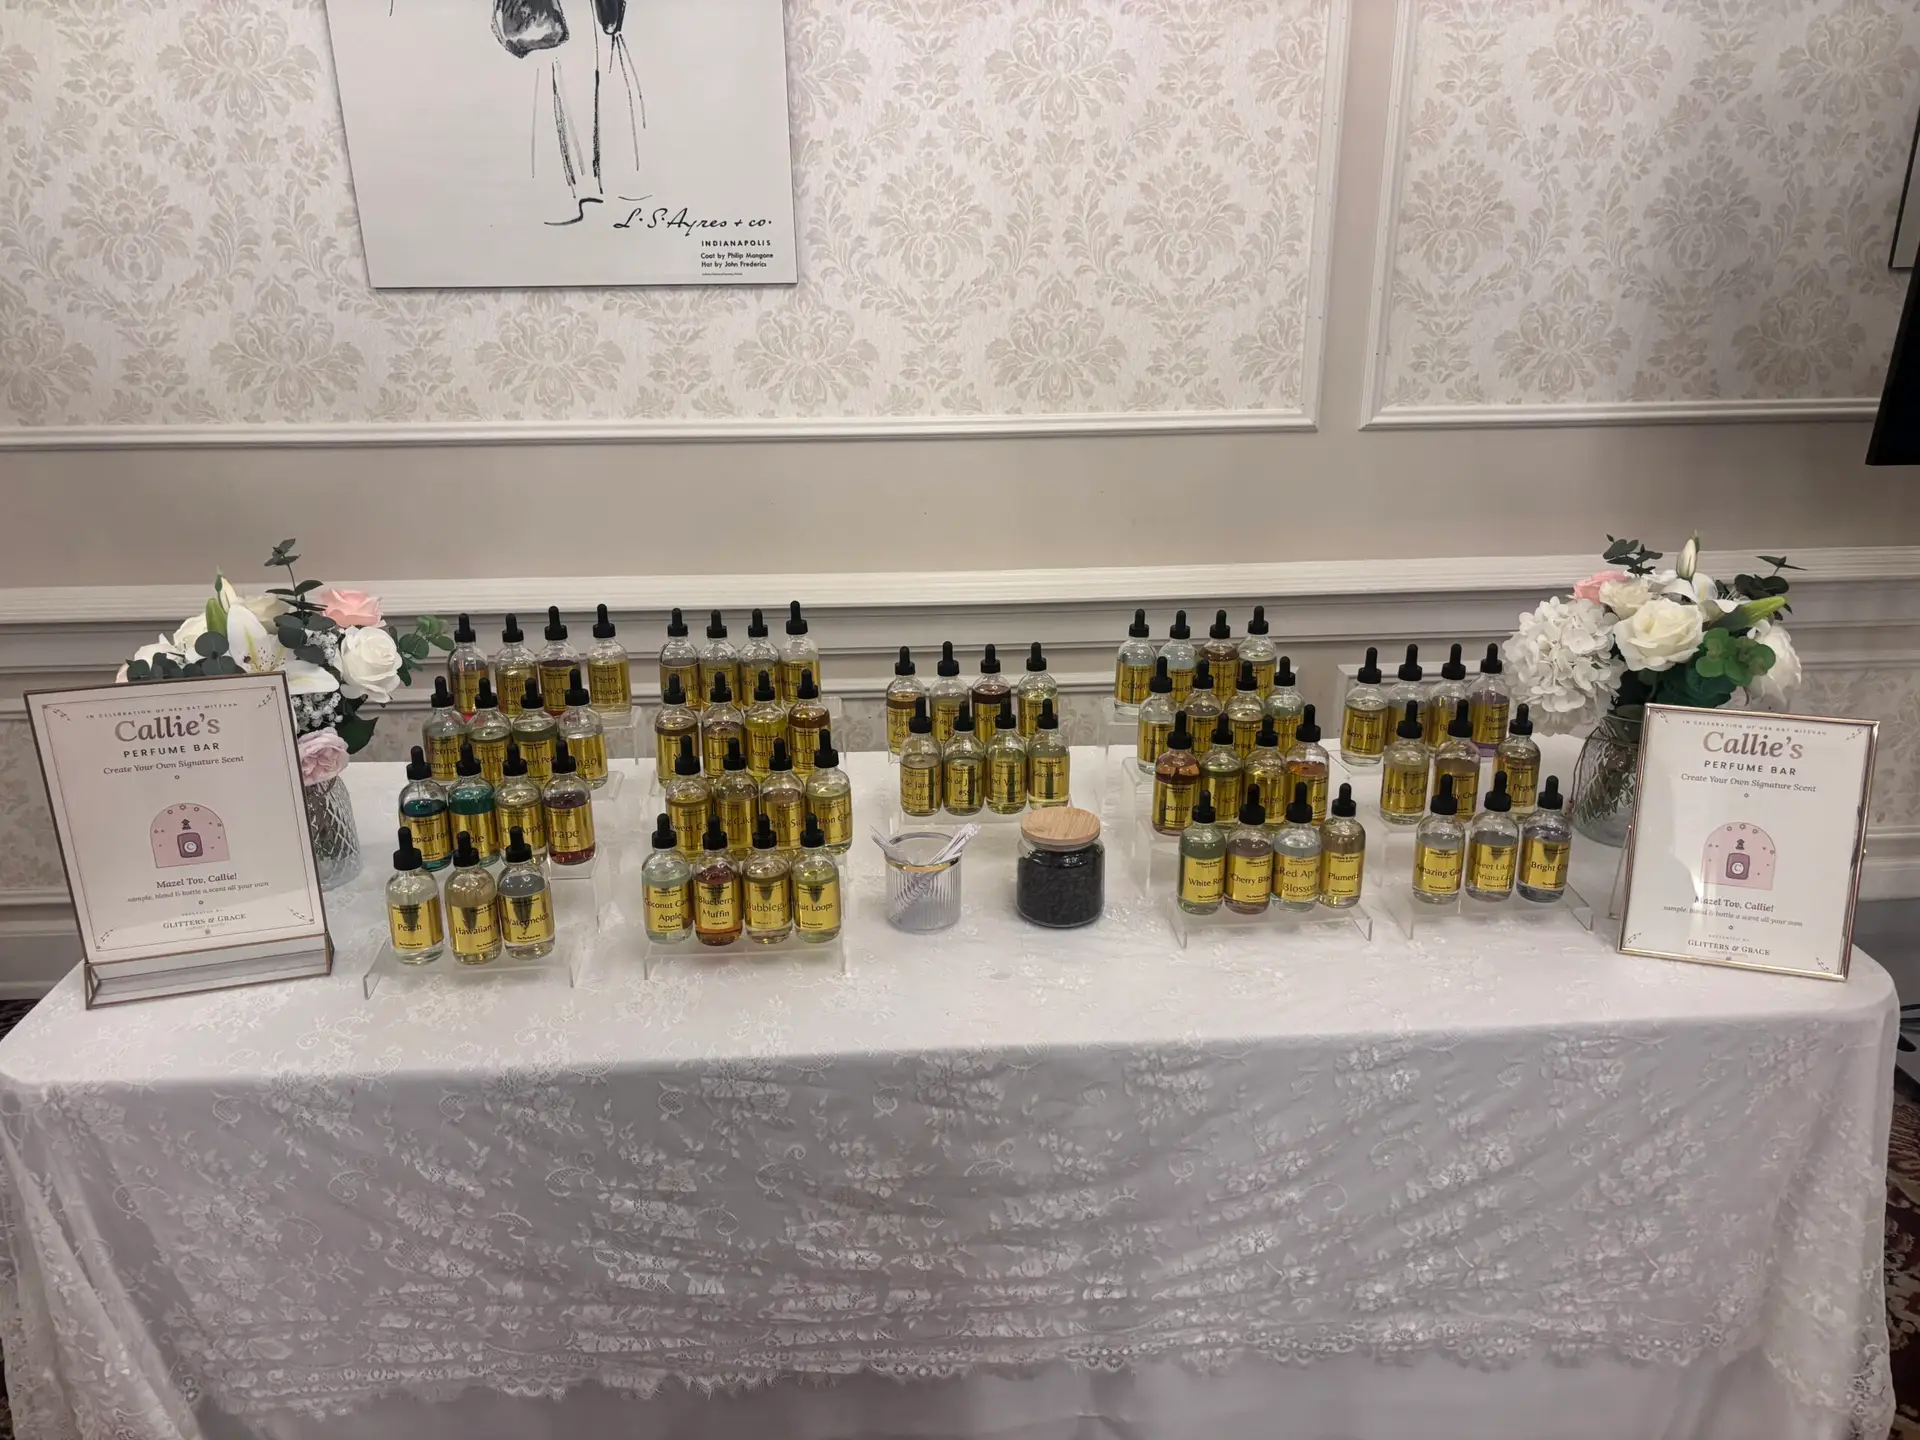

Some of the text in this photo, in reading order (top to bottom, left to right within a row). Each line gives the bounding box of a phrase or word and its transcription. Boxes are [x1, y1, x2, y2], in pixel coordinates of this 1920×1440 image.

[667, 207, 727, 237] Ayres
[701, 239, 771, 247] INDIANAPOLIS
[717, 252, 725, 260] by
[727, 252, 744, 260] Philip
[745, 252, 773, 260] Mangone
[725, 260, 738, 268] John
[739, 260, 767, 268] Frederics
[114, 713, 221, 742] Callie's
[123, 742, 220, 758] PERFUME BAR
[1703, 731, 1803, 759] Callie's
[103, 755, 244, 775] Create Your Own Signature Scent
[1704, 760, 1797, 776] PERFUME BAR
[1681, 773, 1816, 792] Create Your Own Signature Scent
[1279, 867, 1298, 878] Red
[1531, 860, 1555, 873] Bright
[156, 872, 237, 889] Mazel Tov, Callie!
[1188, 877, 1212, 887] White
[1231, 872, 1255, 887] Cherry
[811, 901, 833, 912] Loops
[1723, 899, 1742, 909] Tov,
[1744, 901, 1775, 912] Callie!
[658, 912, 682, 922] Apple
[702, 909, 730, 918] Muffin
[162, 918, 206, 929] GLITTERS
[217, 913, 246, 923] GRACE
[455, 922, 492, 935] Hawaiian
[1687, 939, 1729, 951] GLITTERS
[1741, 945, 1771, 956] GRACE
